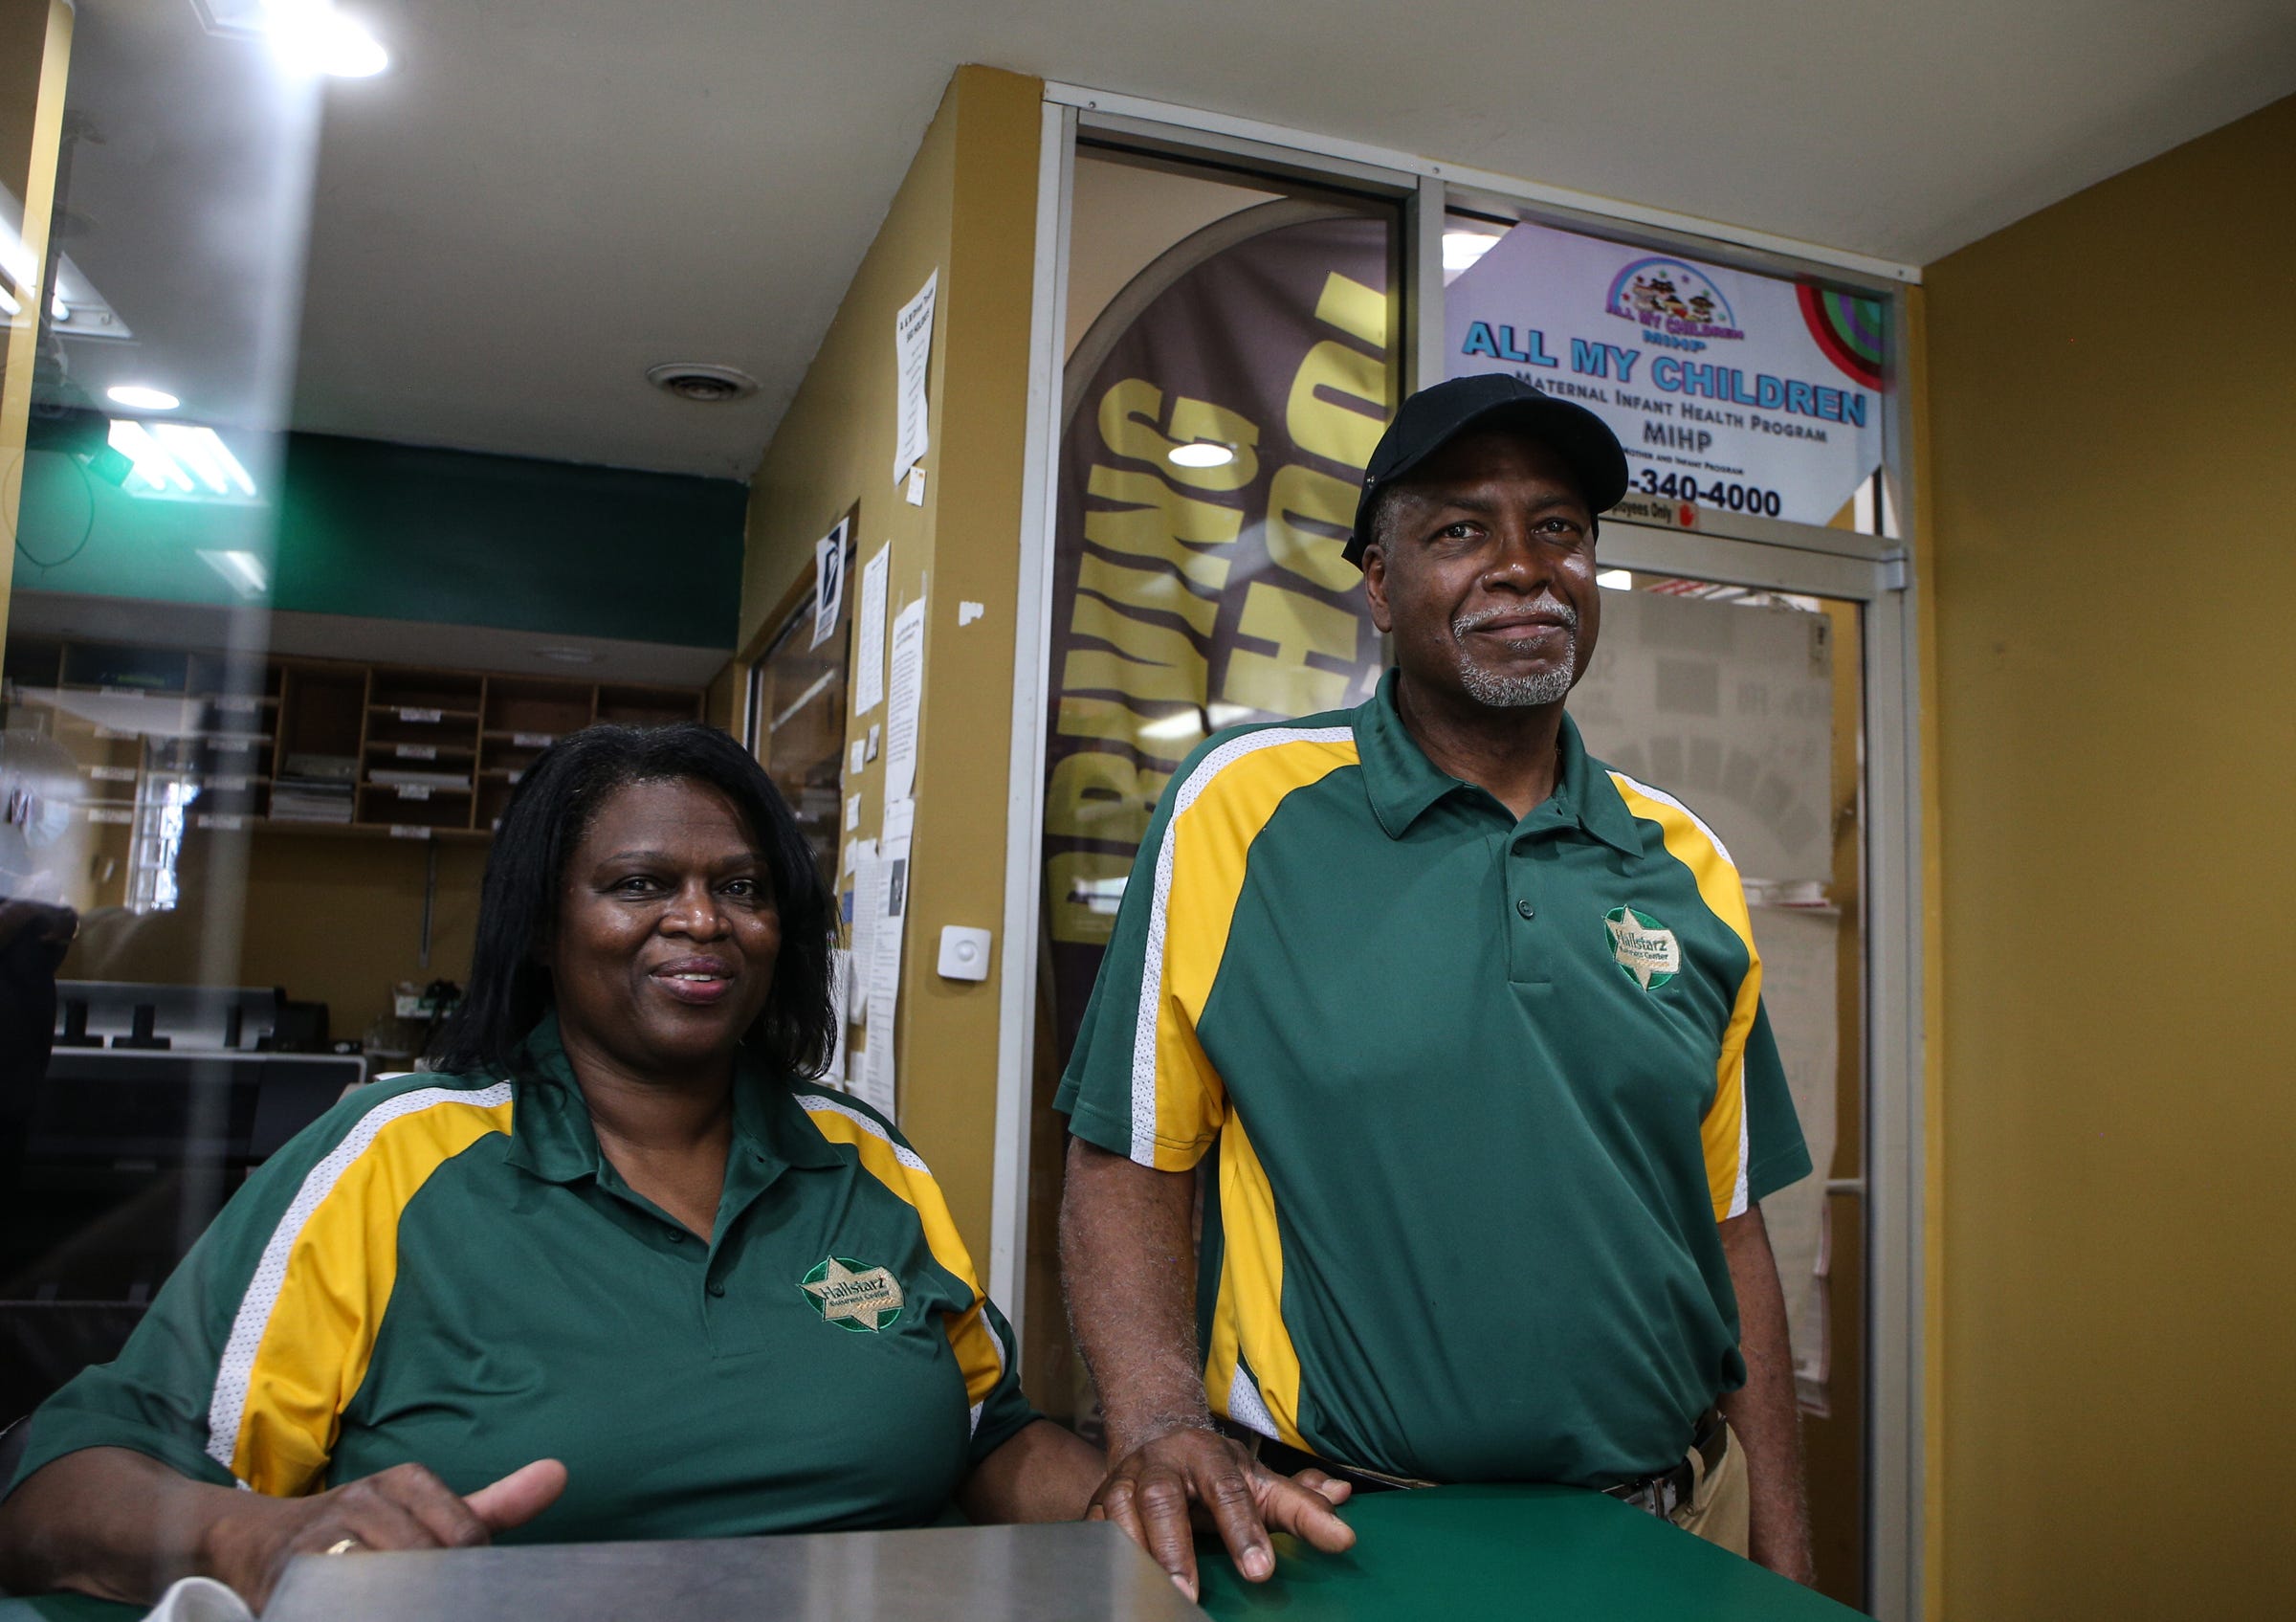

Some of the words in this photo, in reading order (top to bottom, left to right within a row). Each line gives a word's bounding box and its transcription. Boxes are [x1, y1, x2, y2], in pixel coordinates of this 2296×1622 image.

[1605, 304, 1636, 322] ALL
[1638, 310, 1663, 329] MY
[1665, 318, 1745, 341] CHILDREN
[1642, 329, 1708, 352] MIHP
[1461, 321, 1559, 368] ALL
[1570, 337, 1641, 384] MY
[1650, 355, 1866, 429] CHILDREN
[1643, 420, 1712, 454] MIHP
[1628, 468, 1781, 518] -340-4000
[1612, 500, 1649, 518] ployees
[1650, 501, 1673, 523] Only
[1615, 928, 1668, 952] Hallstarz
[819, 1277, 886, 1300] Hallstarz
